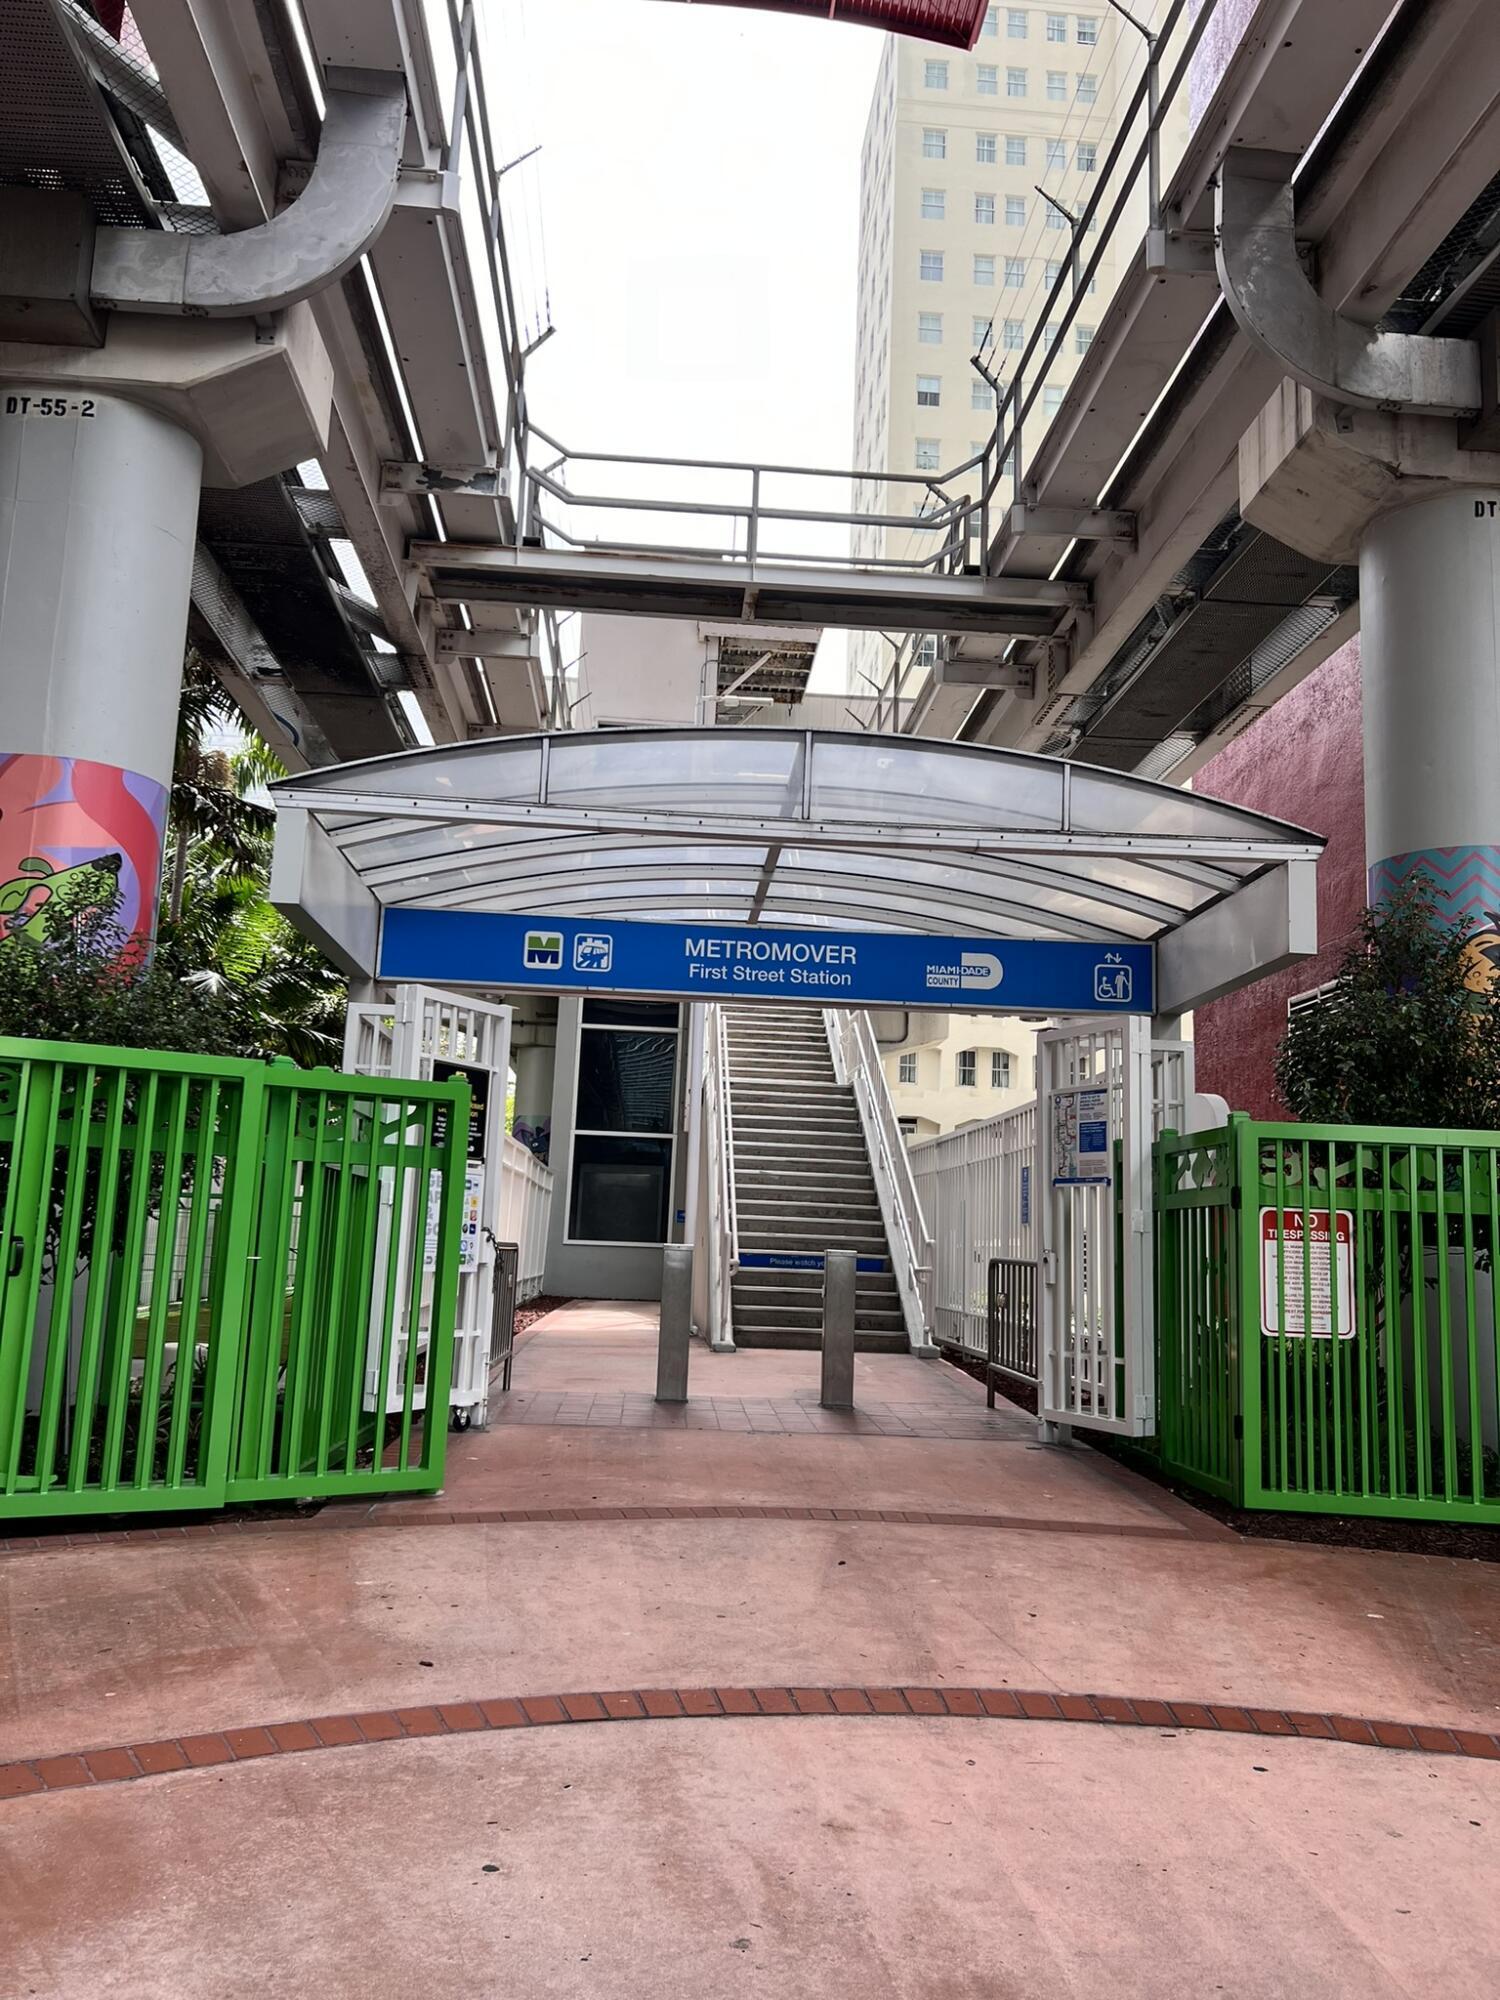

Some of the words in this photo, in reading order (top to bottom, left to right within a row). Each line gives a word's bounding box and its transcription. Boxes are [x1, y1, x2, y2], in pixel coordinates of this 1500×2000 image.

[6, 396, 96, 418] DT-55-2
[1474, 500, 1500, 518] DT
[685, 938, 857, 965] METROMOVER
[689, 963, 728, 980] First
[732, 965, 785, 983] Street
[790, 968, 852, 986] Station
[927, 976, 959, 986] COUNTY
[1267, 1228, 1345, 1241] TESPSSIG
[769, 1257, 793, 1266] Please
[795, 1258, 817, 1267] watch
